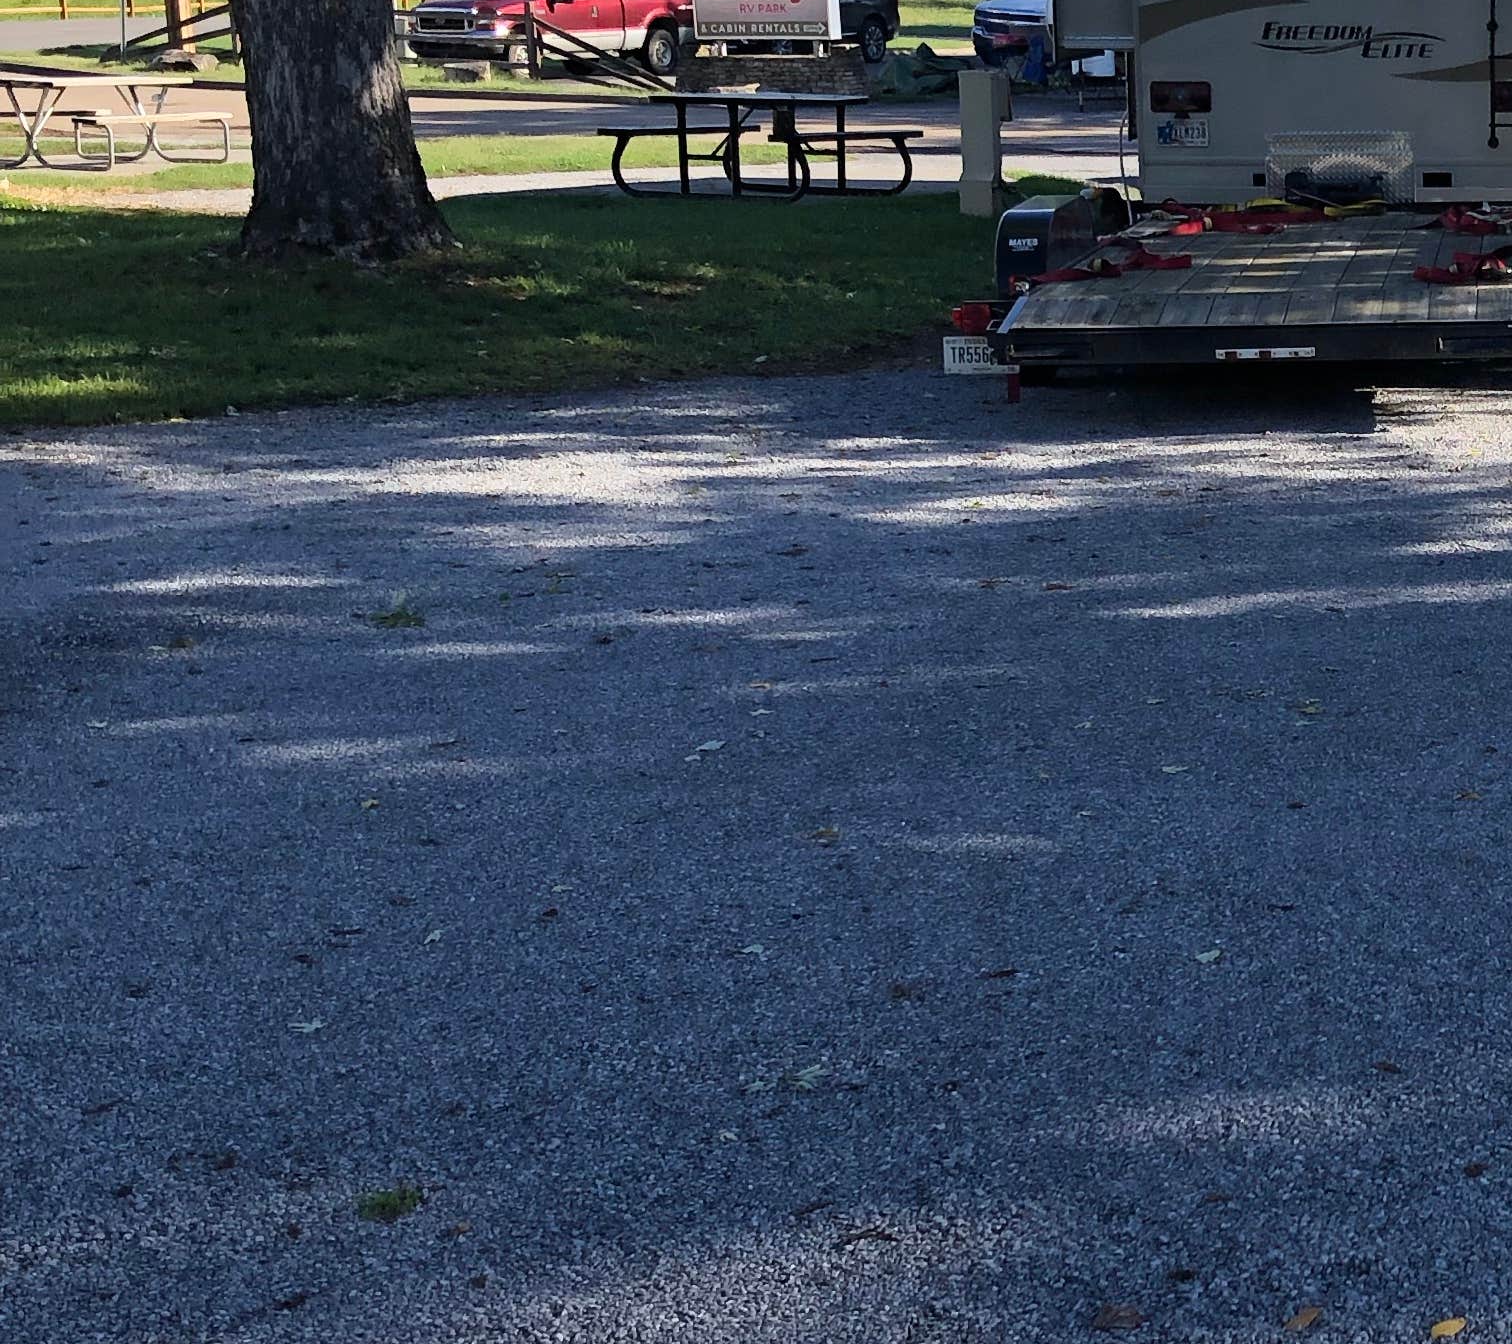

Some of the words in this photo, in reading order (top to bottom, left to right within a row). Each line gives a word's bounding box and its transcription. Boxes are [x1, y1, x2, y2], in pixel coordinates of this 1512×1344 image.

[739, 4, 754, 14] RV
[758, 4, 788, 14] PARK
[710, 24, 746, 33] CABIN
[751, 24, 800, 33] RENTALS
[1261, 21, 1374, 41] FREEDOM
[1361, 40, 1435, 59] ELITE
